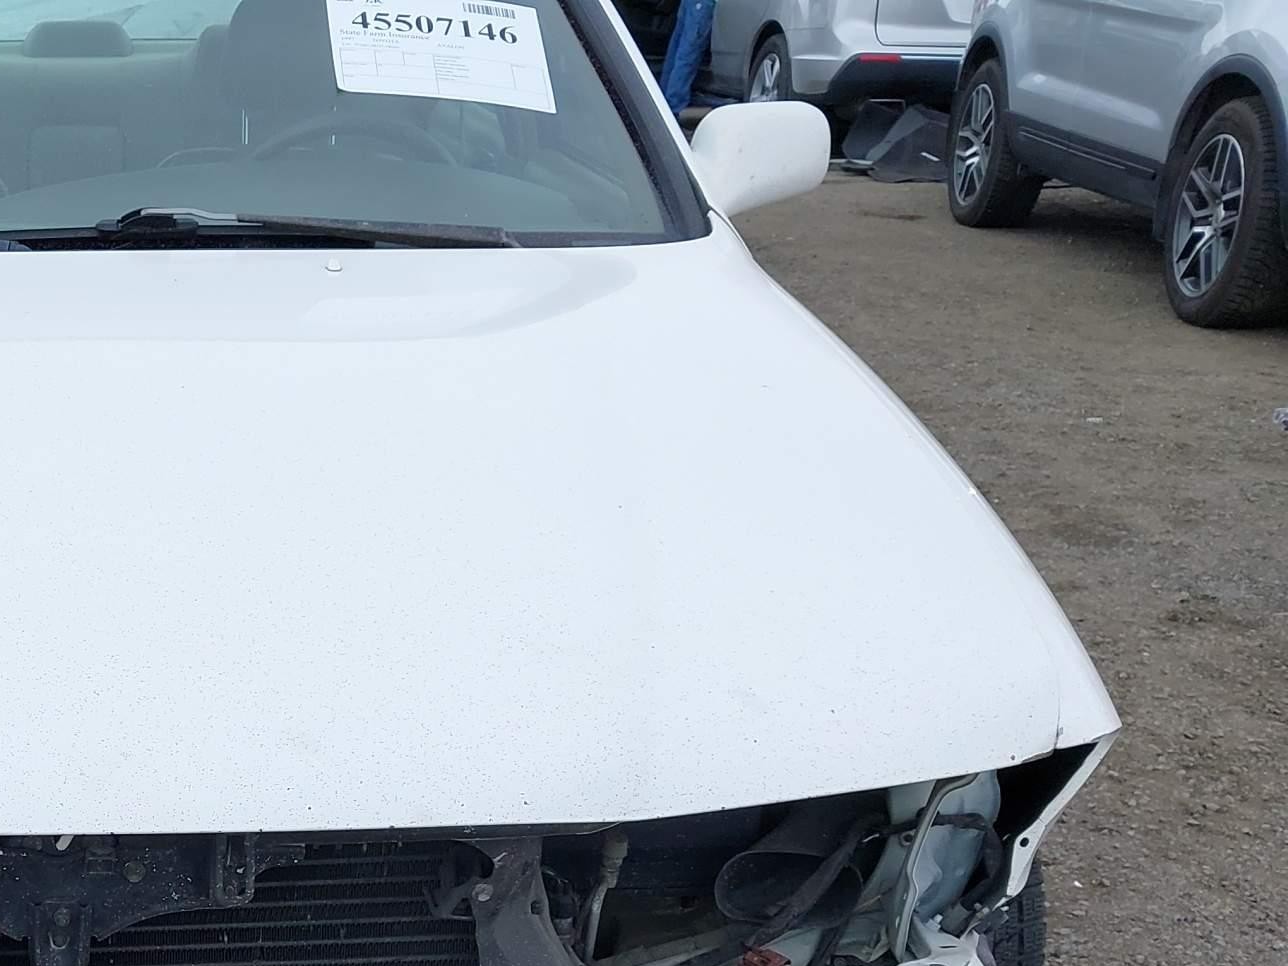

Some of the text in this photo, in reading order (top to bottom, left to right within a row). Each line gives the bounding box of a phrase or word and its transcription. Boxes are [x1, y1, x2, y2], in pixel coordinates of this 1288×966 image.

[340, 28, 361, 36] State
[363, 30, 386, 38] Farm
[388, 31, 430, 41] Insurance
[352, 11, 518, 44] 45507146
